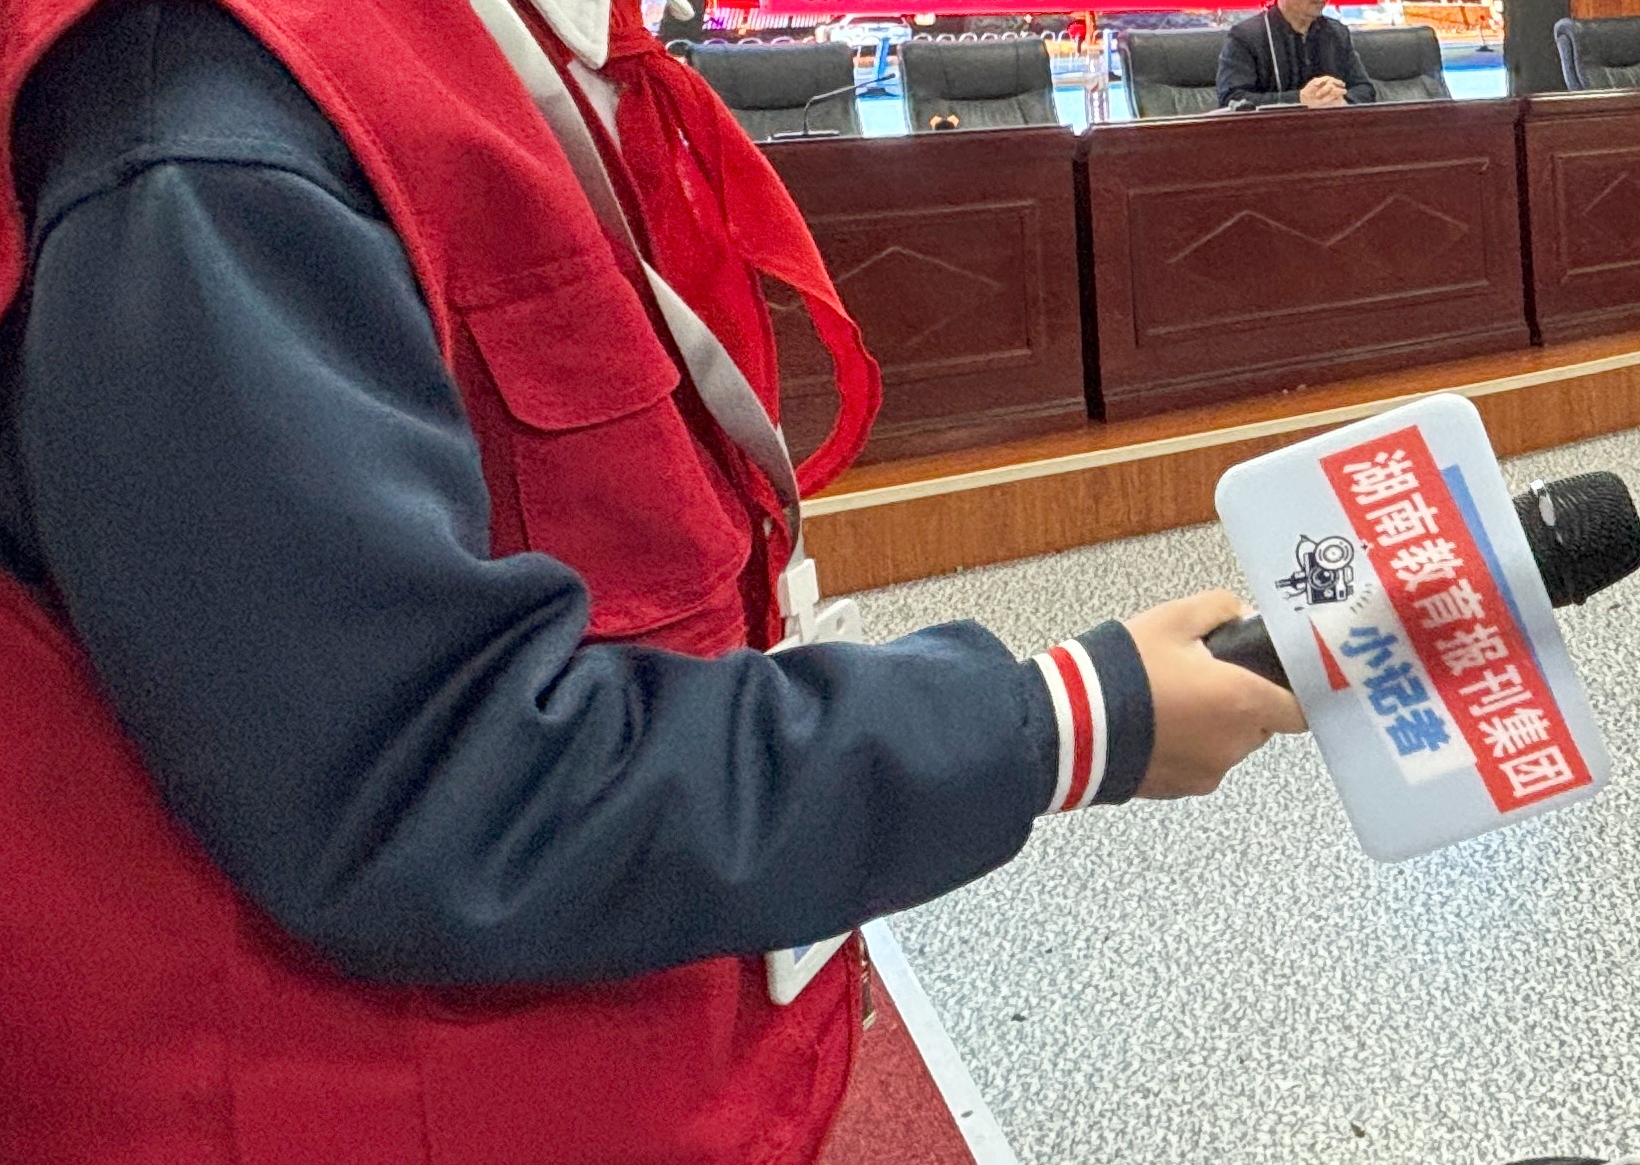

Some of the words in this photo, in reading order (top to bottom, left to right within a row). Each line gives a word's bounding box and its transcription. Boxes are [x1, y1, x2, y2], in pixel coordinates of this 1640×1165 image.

[1339, 626, 1451, 756] 小记者
[1343, 448, 1575, 798] 湖南教育报刊集团
